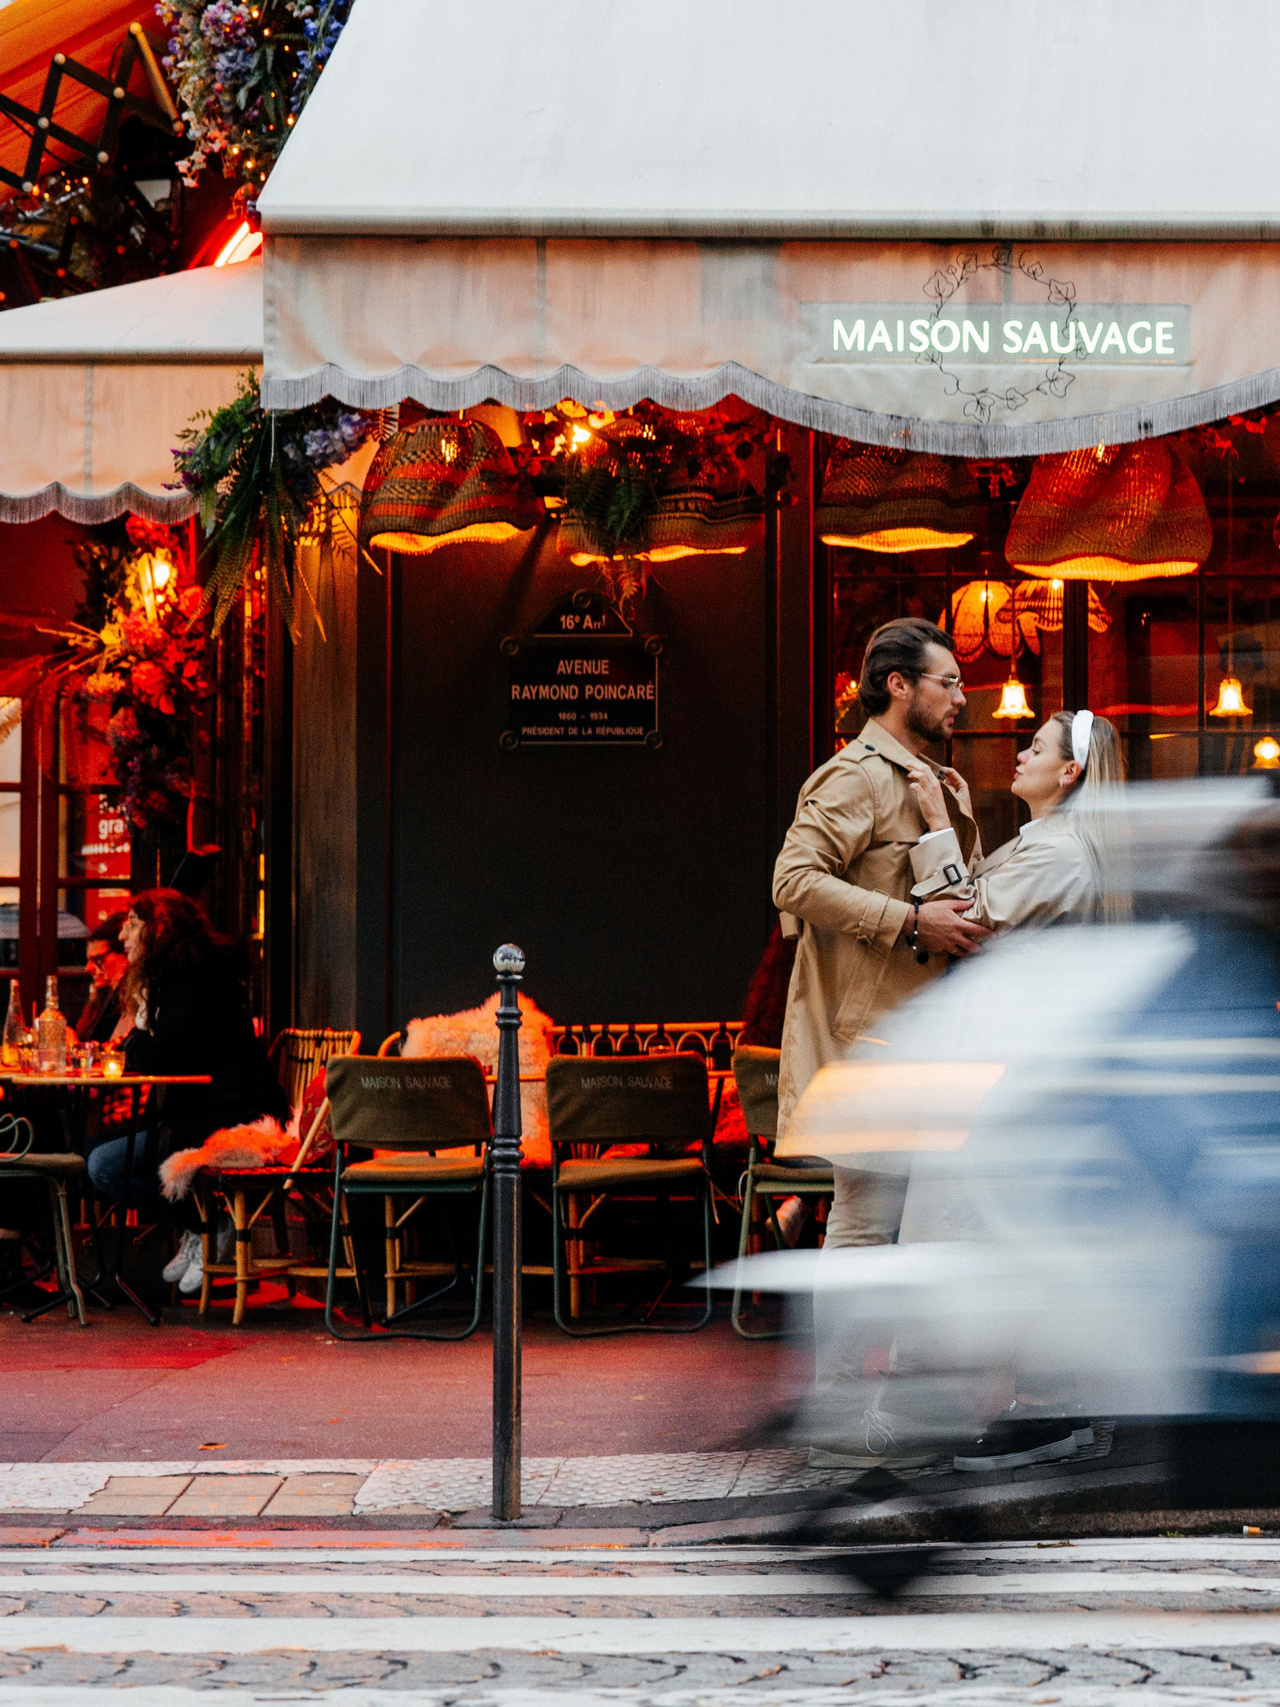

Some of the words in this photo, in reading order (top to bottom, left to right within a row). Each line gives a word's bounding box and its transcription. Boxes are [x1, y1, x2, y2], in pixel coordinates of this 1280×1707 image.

[832, 318, 990, 353] MAISON
[1002, 319, 1176, 356] SAUVAGE
[556, 660, 610, 675] AVENUE
[511, 685, 579, 700] RAYMOND
[585, 680, 655, 700] POINCARÉ
[521, 725, 565, 736] PRÉSIDENT
[568, 726, 579, 736] DE
[581, 726, 593, 736] LA
[596, 725, 644, 737] RÉPUBLIQUE
[361, 1076, 401, 1089] MAISON
[404, 1075, 453, 1090] SAUVAGE
[581, 1075, 624, 1089] MAISON
[627, 1075, 674, 1090] SAUVAGE
